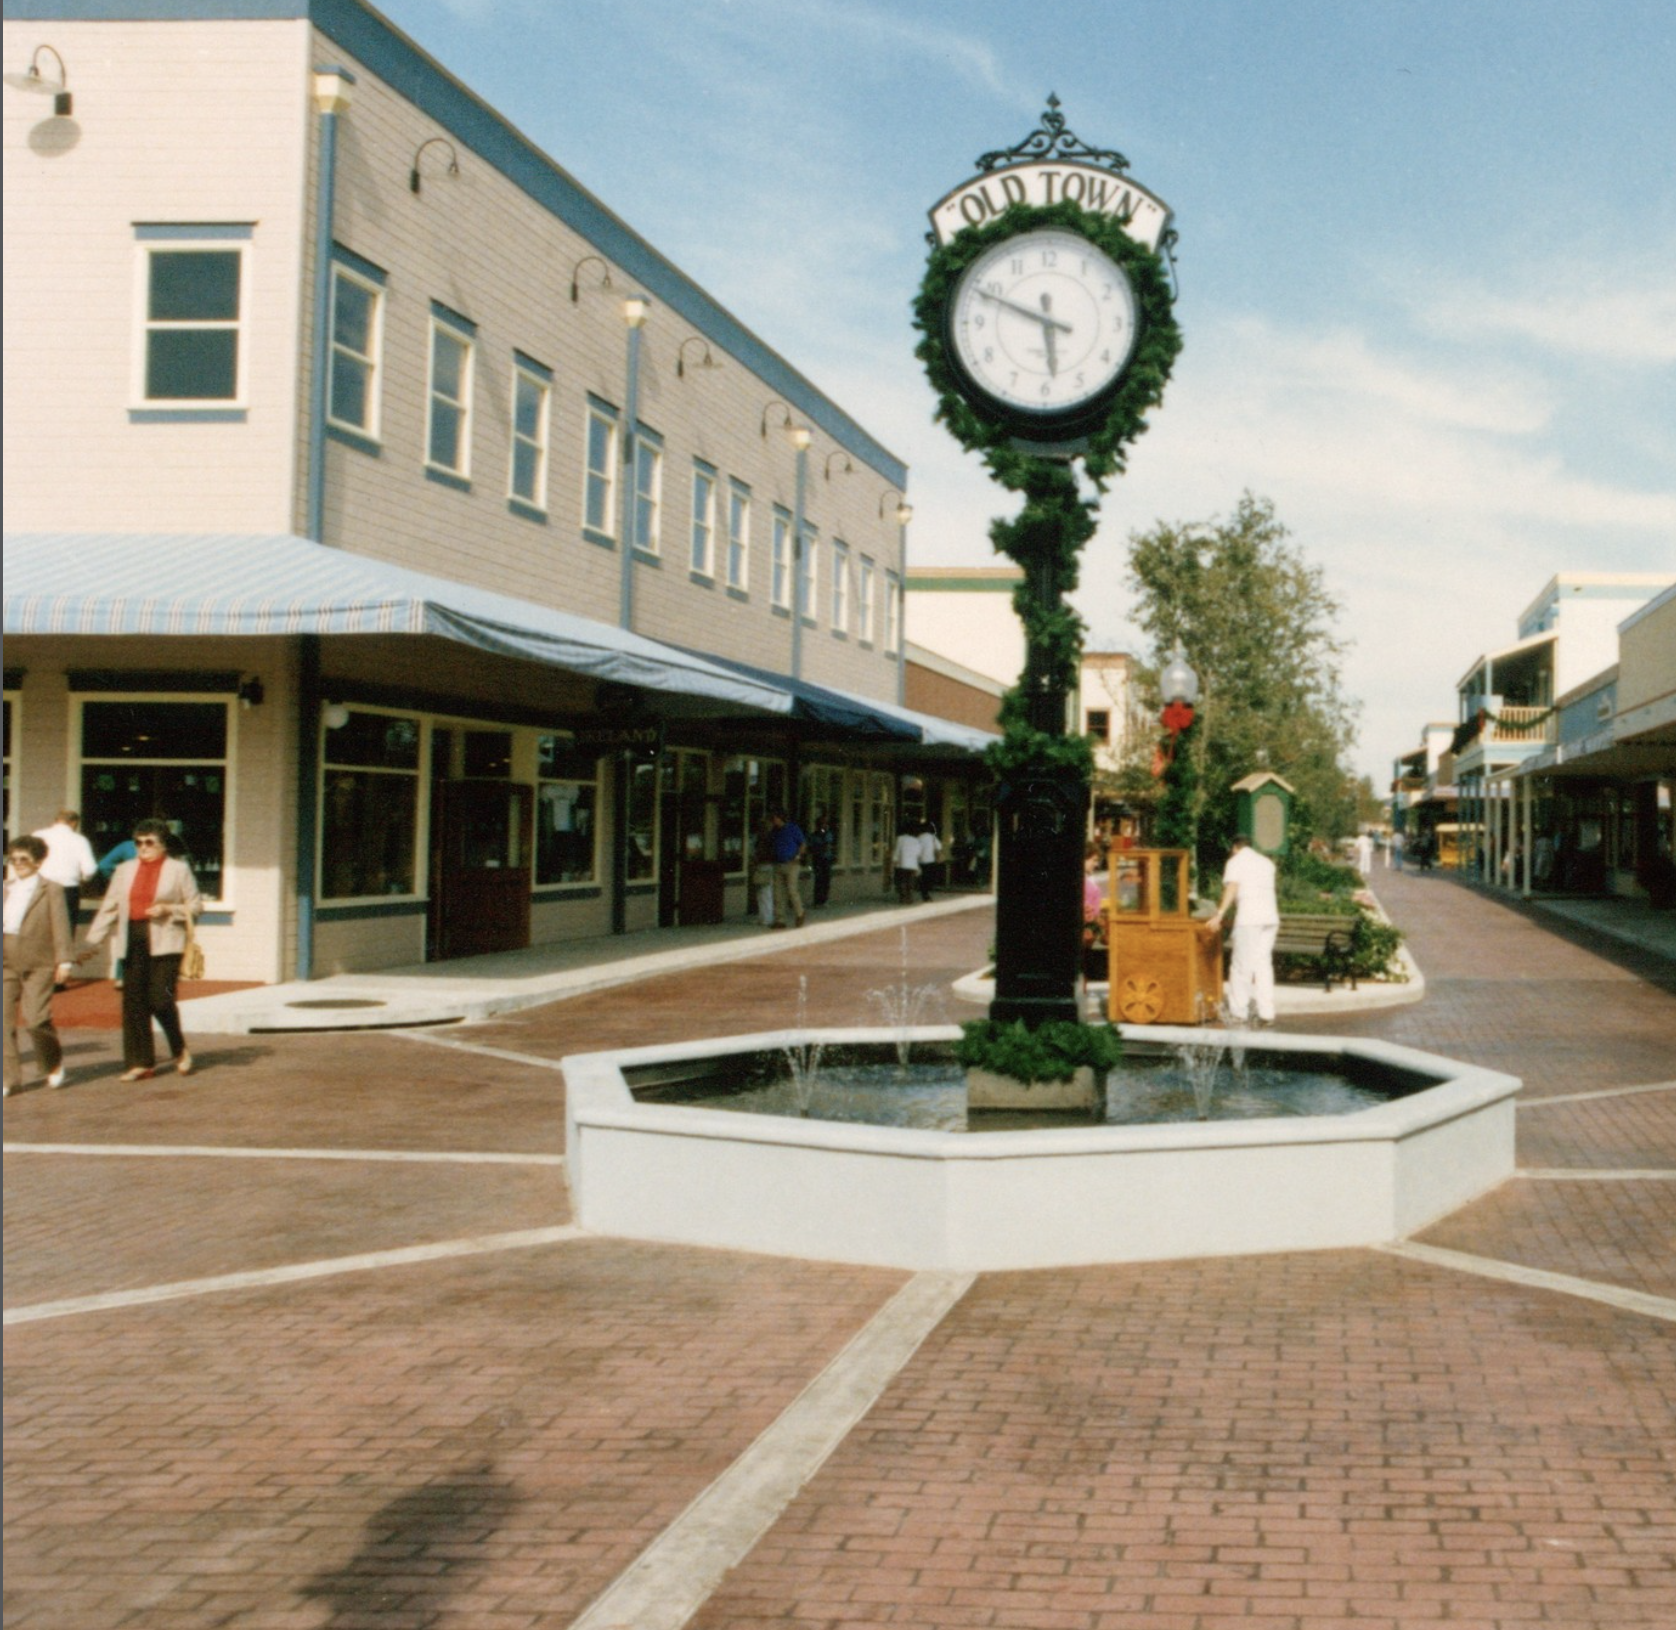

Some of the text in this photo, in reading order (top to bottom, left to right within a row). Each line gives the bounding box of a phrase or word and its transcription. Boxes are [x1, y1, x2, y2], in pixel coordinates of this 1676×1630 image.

[1012, 259, 1023, 276] 11
[1042, 251, 1057, 268] 12
[986, 281, 1003, 297] 10
[1102, 283, 1112, 301] 2
[975, 315, 985, 331] 9
[1113, 316, 1122, 333] 3
[984, 346, 994, 364] 8
[1100, 348, 1110, 364] 4
[1009, 371, 1019, 387] 7
[1073, 372, 1084, 389] 5
[1040, 380, 1050, 397] 6
